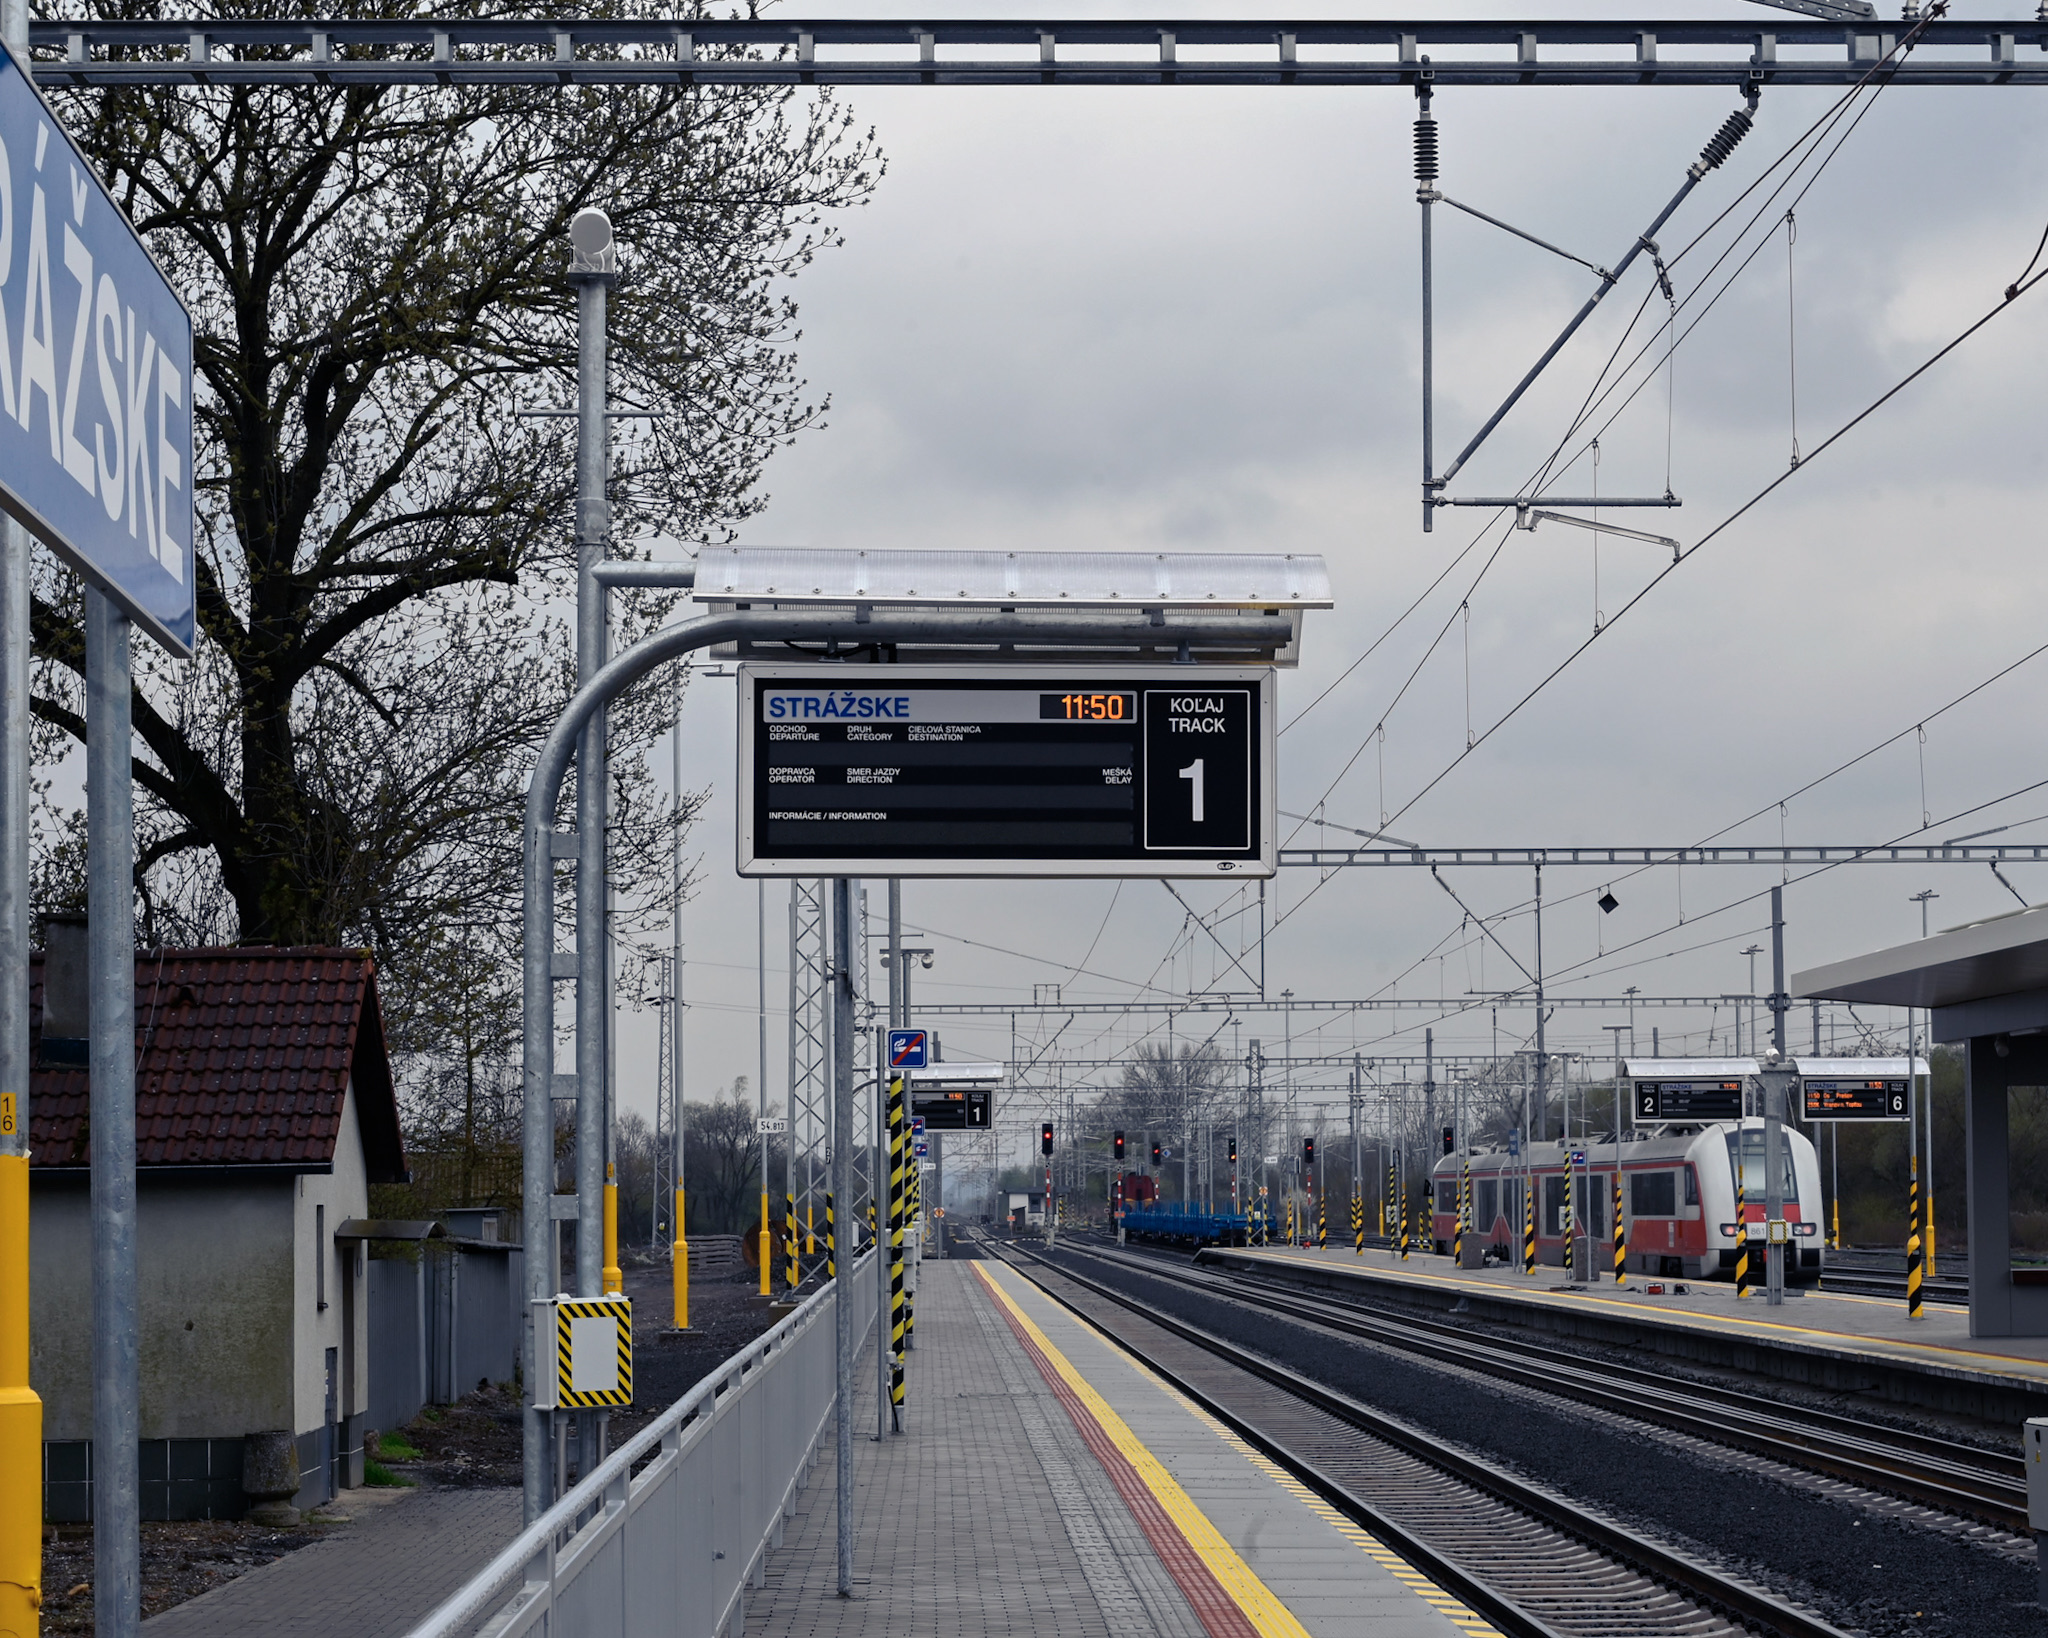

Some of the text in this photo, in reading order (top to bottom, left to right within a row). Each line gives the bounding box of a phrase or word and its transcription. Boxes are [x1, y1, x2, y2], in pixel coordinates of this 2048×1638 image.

[769, 692, 910, 718] STRÁŽSKE
[1061, 694, 1123, 720] 11:50
[1170, 697, 1224, 714] KOĽAJ
[769, 725, 807, 733] ODCHOD
[847, 725, 872, 733] DRUH
[908, 724, 982, 734] CIEĽOVÁ STANICA
[1168, 717, 1226, 733] TRACK
[769, 733, 820, 741] DEPARTURE
[847, 733, 893, 741] CATEGORY
[908, 733, 964, 741] DESTINATION
[769, 767, 816, 775] DOPRAVCA
[872, 768, 901, 776] JAZDY
[1102, 767, 1133, 776] MEŠKÁ
[769, 775, 815, 783] OPERATOR
[847, 776, 893, 784] DIRECTION
[1105, 776, 1133, 785] DELAY
[1178, 758, 1204, 822] 1
[769, 811, 822, 820] INFORMÁCIE
[828, 812, 887, 820] INFORMATION
[1643, 1096, 1654, 1113] 2
[1892, 1095, 1903, 1111] 6
[973, 1106, 980, 1122] 1
[760, 1121, 785, 1131] 54.813
